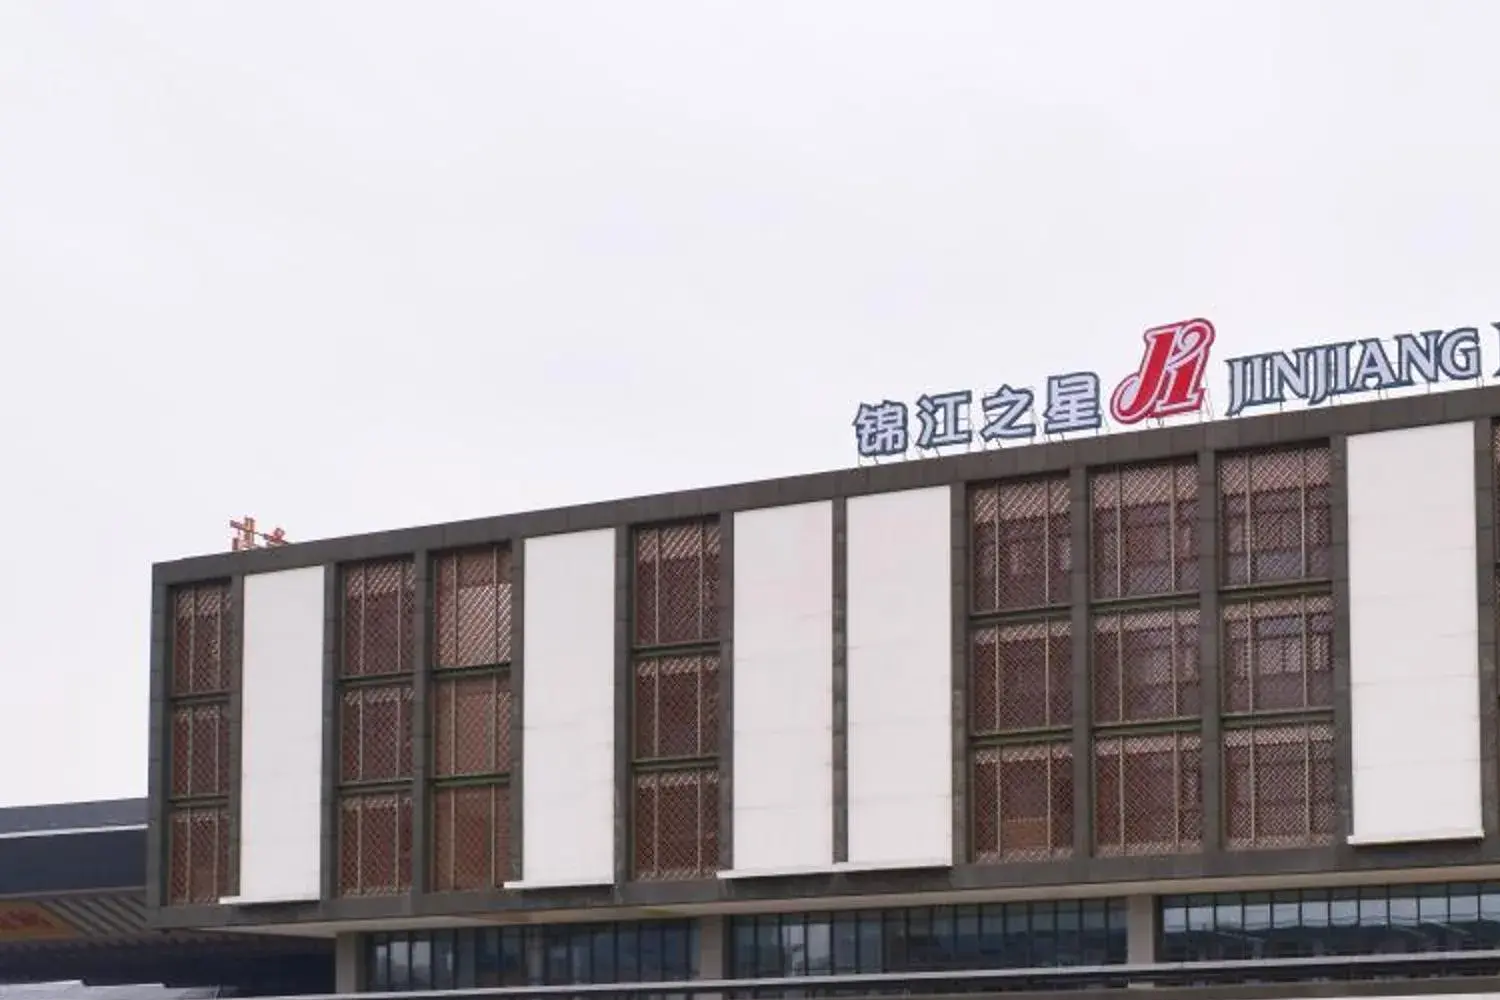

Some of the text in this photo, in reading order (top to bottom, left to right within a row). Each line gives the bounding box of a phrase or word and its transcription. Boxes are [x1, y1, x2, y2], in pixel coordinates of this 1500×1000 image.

[853, 372, 1101, 456] 锦江之星
[1225, 326, 1483, 416] JINJIANG
